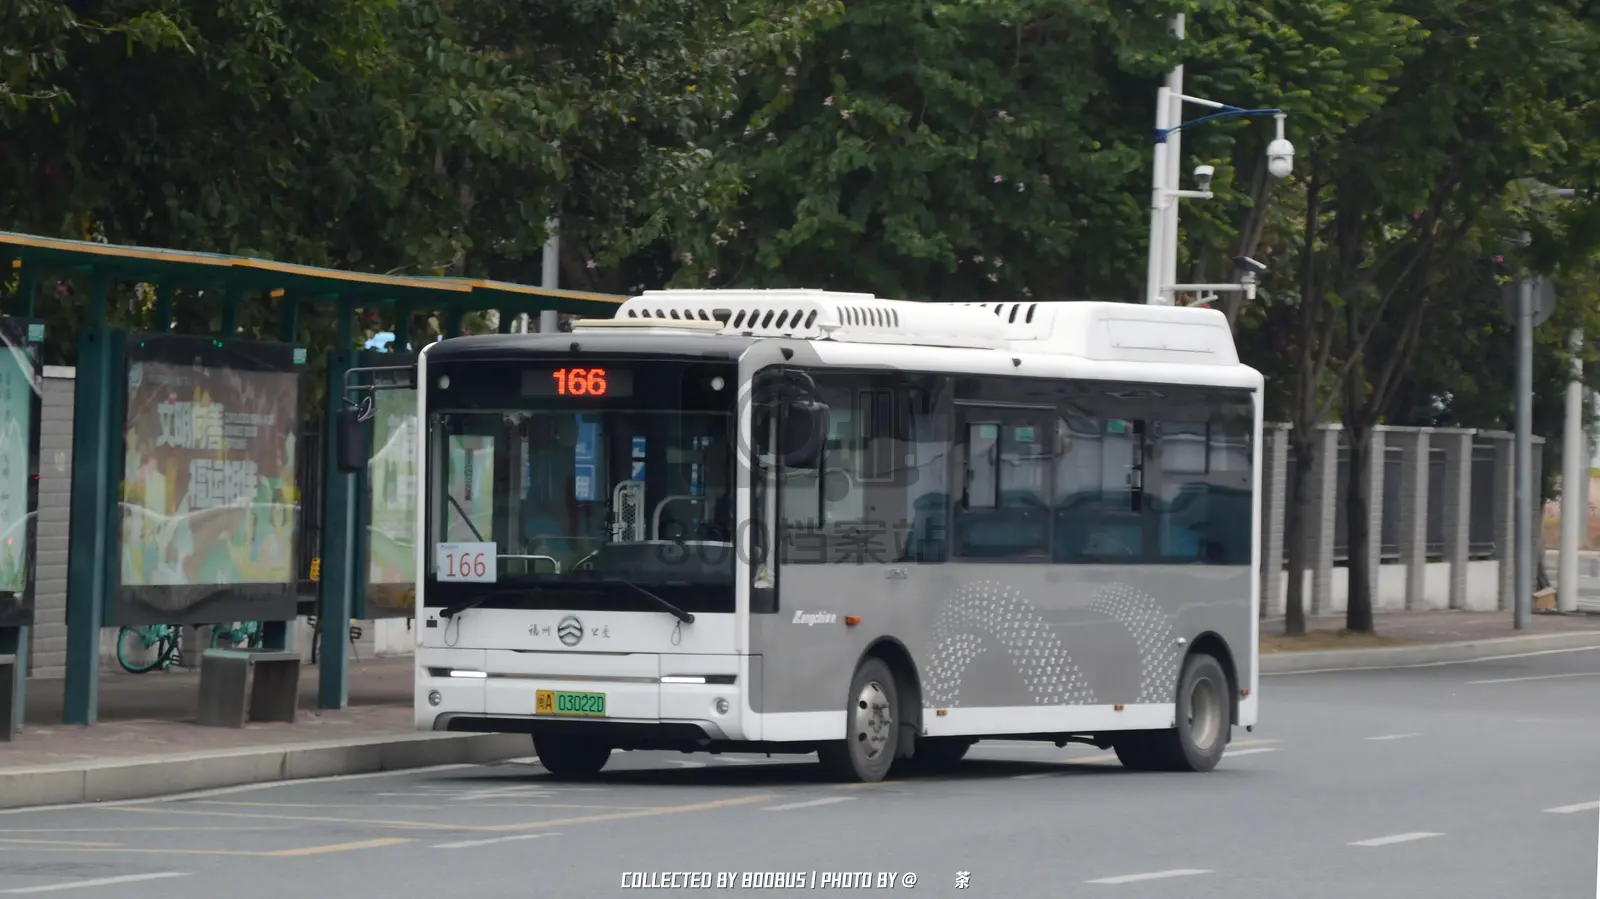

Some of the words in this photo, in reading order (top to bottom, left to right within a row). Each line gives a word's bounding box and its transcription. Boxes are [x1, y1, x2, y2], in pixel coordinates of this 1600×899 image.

[553, 368, 607, 396] 166
[446, 552, 486, 577] 166
[558, 695, 604, 713] 03022D
